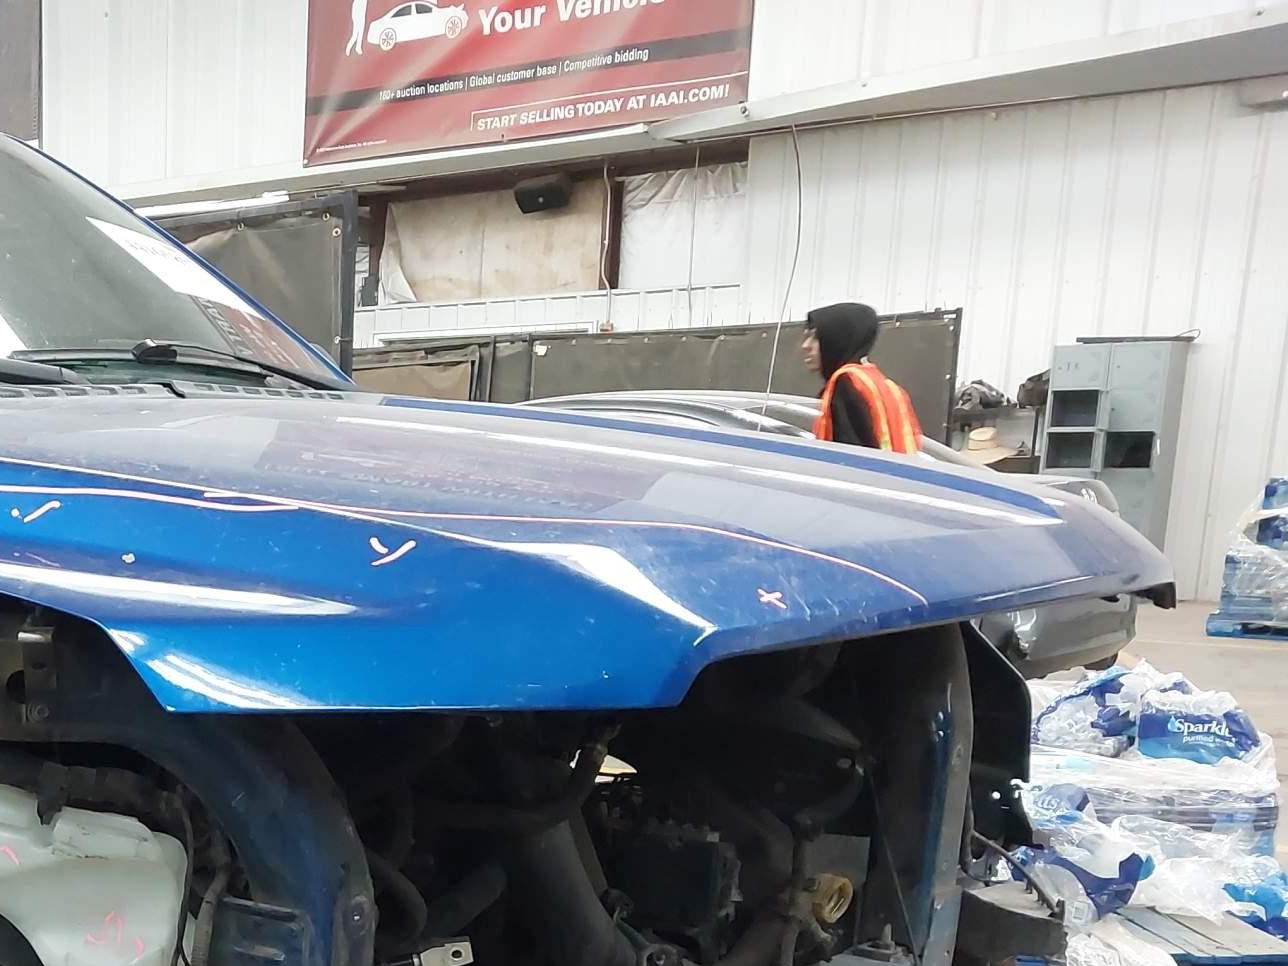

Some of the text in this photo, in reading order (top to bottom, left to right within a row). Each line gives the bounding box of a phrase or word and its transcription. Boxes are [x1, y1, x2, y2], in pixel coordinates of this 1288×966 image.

[478, 0, 663, 35] Your Vehic
[396, 86, 426, 99] auction
[427, 80, 464, 94] locations
[470, 75, 495, 87] Global
[497, 68, 535, 83] customer
[537, 65, 557, 77] base
[564, 55, 613, 72] Competitive
[615, 48, 649, 63] bidding
[477, 83, 730, 130] START SELLING TODAY AT IAAI.COM!
